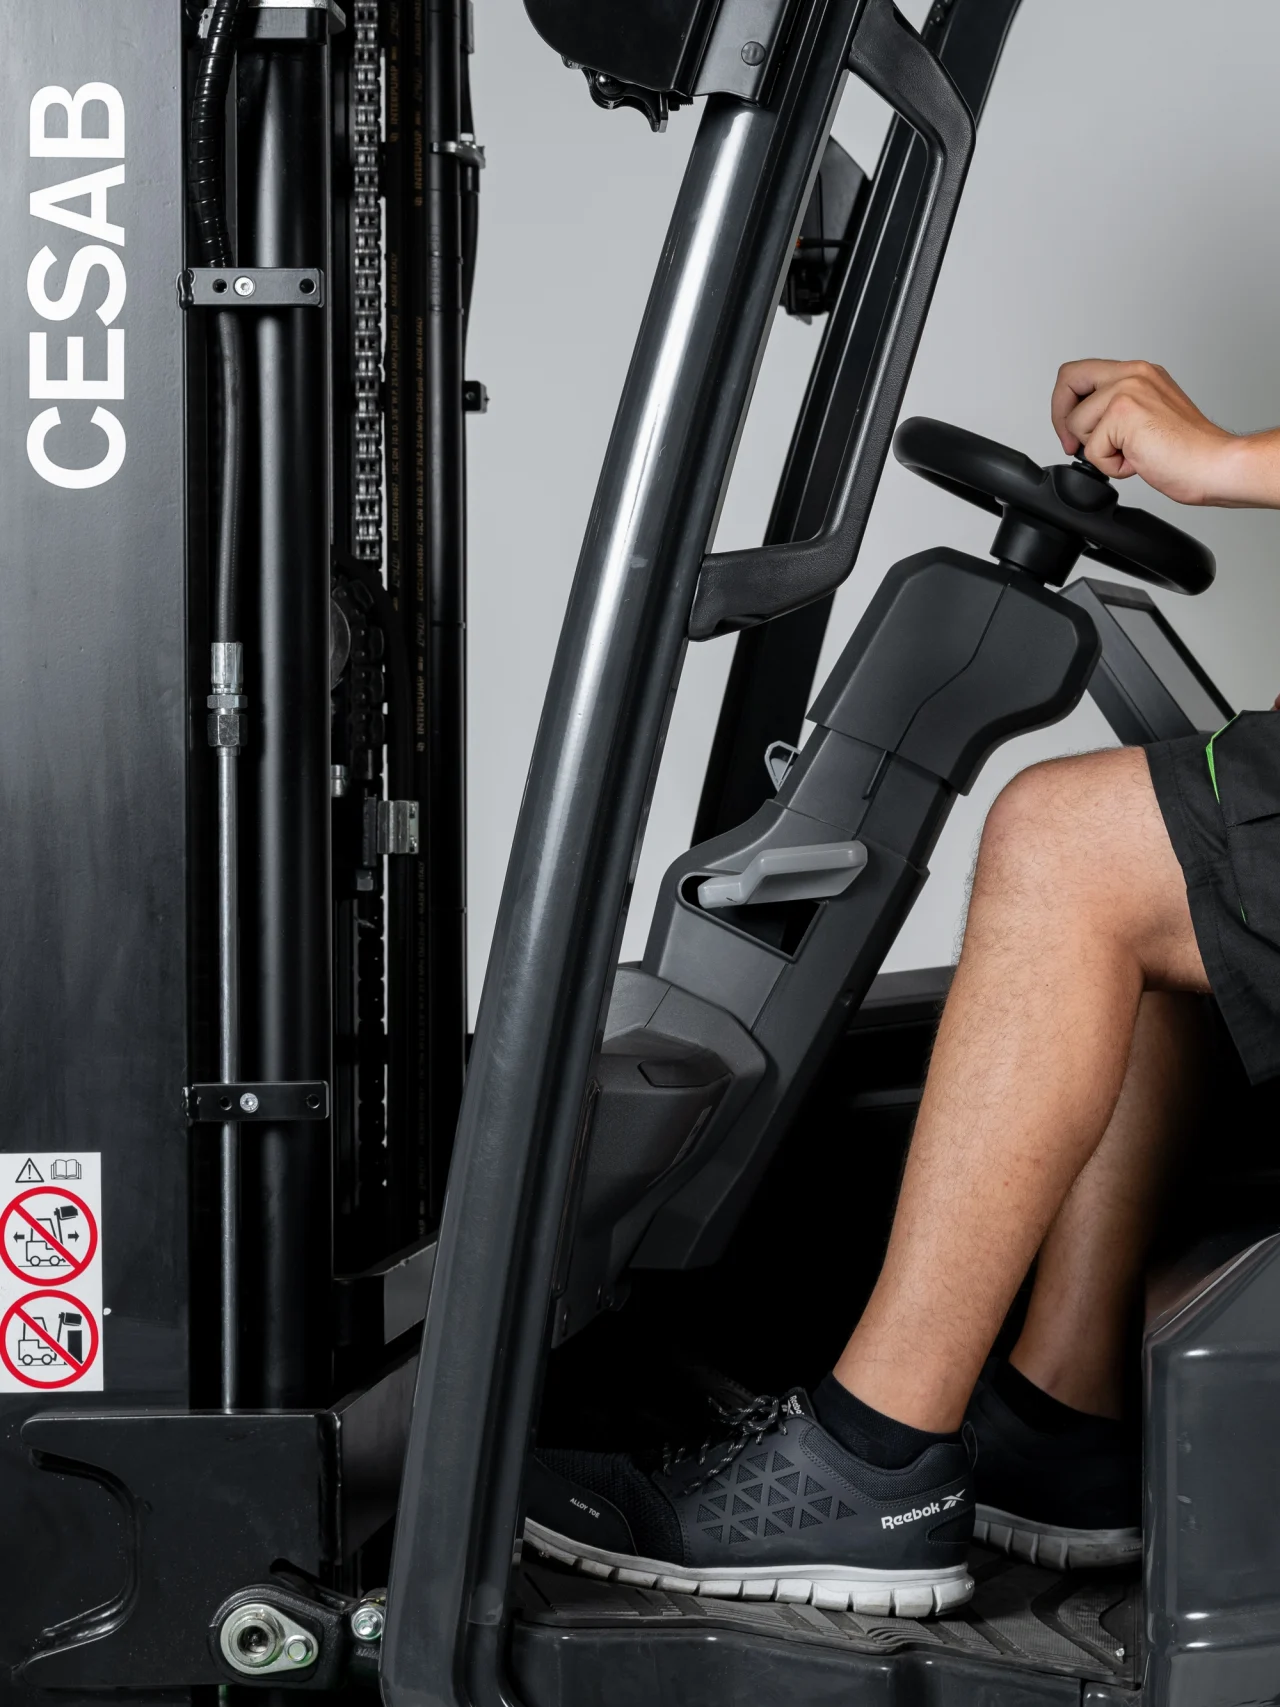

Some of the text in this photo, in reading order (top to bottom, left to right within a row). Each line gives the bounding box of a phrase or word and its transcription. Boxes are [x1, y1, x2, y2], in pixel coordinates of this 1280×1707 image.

[390, 65, 399, 125] INTERPUMP
[413, 130, 423, 190] INTERPUMP
[27, 81, 126, 489] CESAB
[391, 508, 399, 541] EXCEEDS
[415, 676, 425, 735] INTERPUMP
[790, 1395, 804, 1415] Reebo
[570, 1497, 601, 1519] ALLOY TOE
[880, 1502, 941, 1530] Reebok
